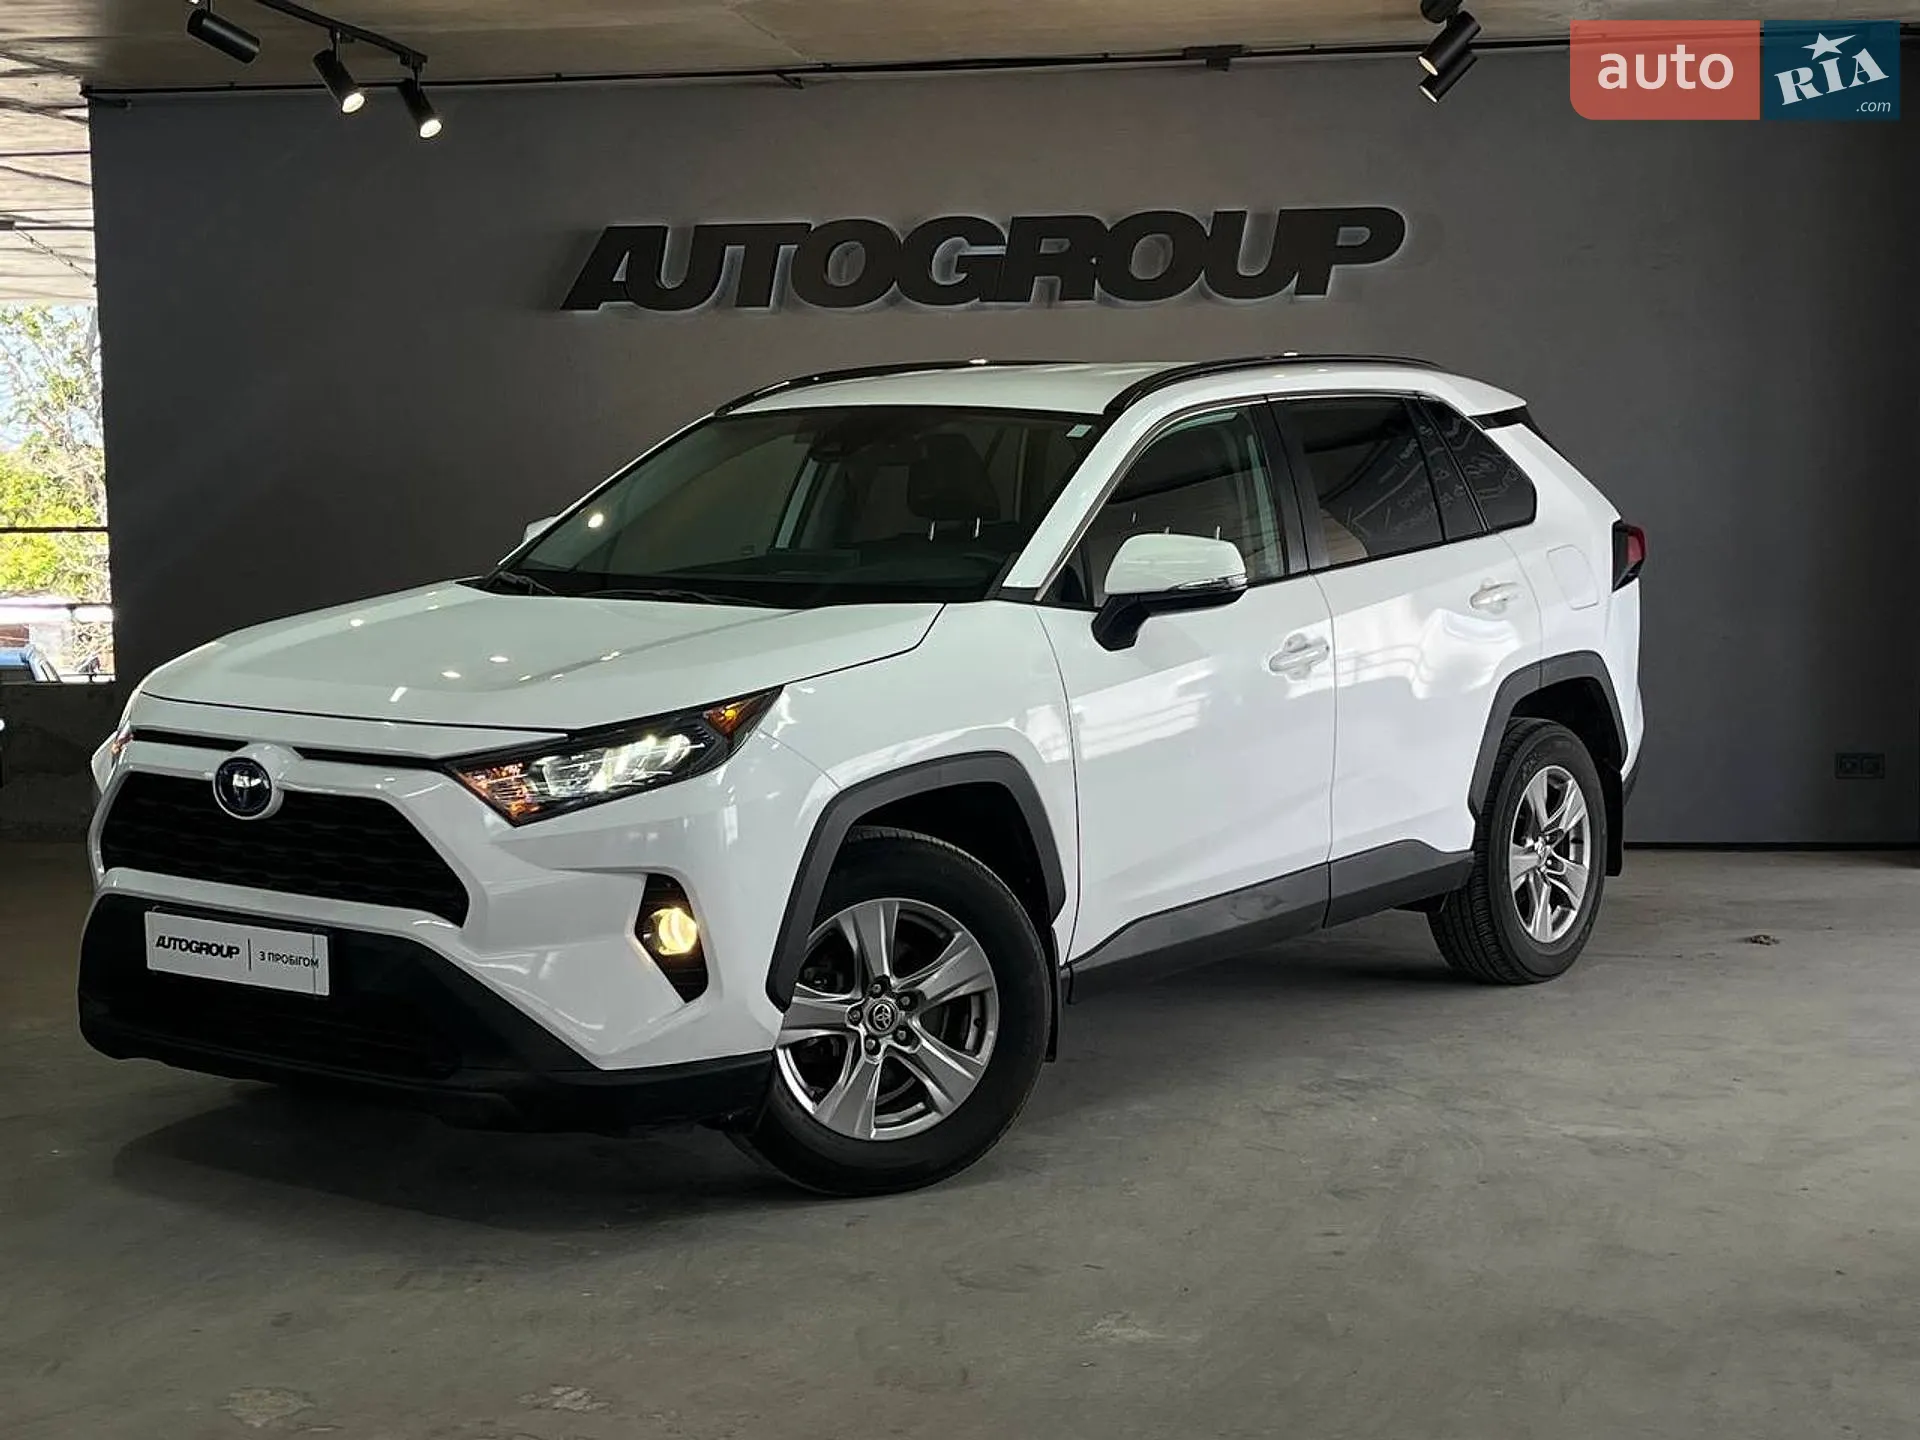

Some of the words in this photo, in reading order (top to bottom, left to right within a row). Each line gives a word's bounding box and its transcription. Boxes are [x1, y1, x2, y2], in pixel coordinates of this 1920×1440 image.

[561, 207, 1405, 312] AUTOGROUP
[155, 935, 240, 959] AUTOGROUP
[268, 952, 319, 969] ПРОБІГОМ
